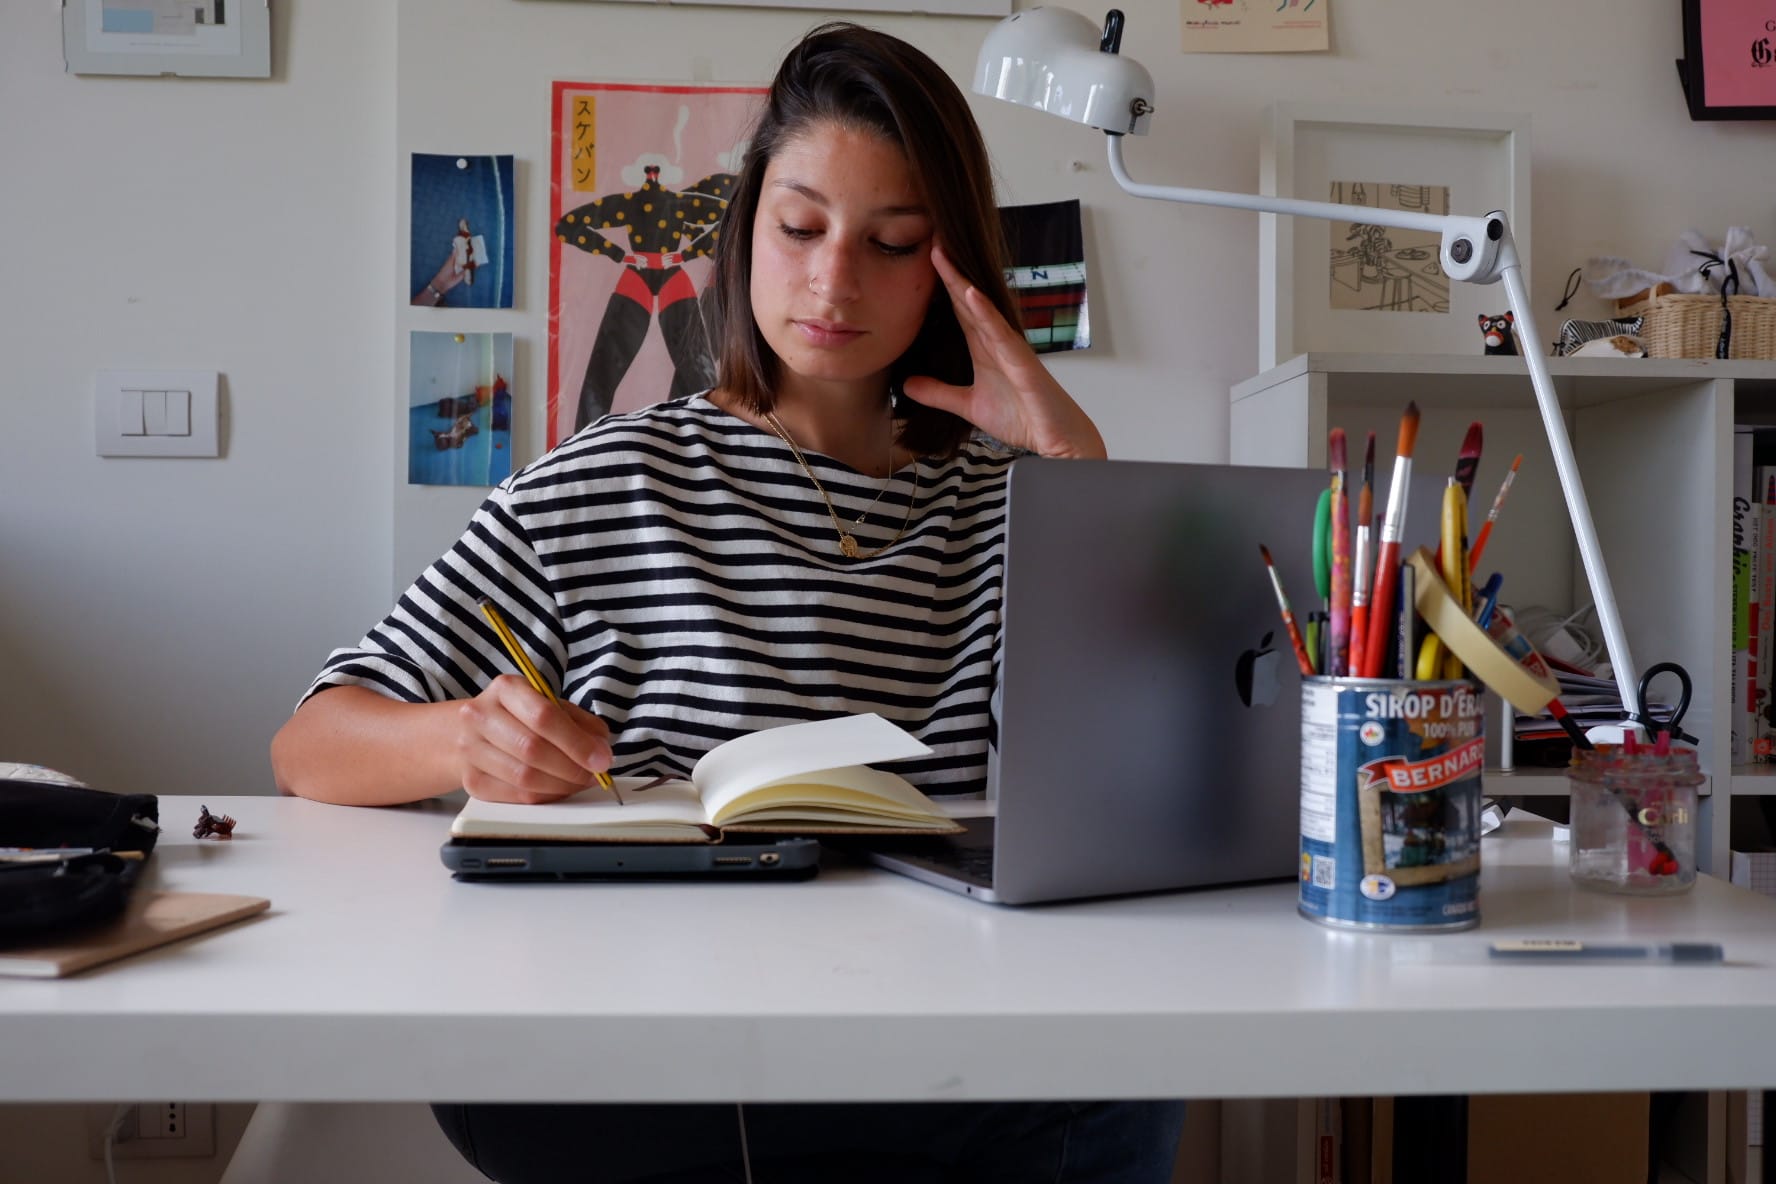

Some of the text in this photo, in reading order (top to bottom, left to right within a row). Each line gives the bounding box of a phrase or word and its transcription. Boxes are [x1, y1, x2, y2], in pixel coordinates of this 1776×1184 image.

[574, 99, 595, 184] スケバン
[1365, 692, 1435, 719] SIROP
[1424, 722, 1456, 739] 100%
